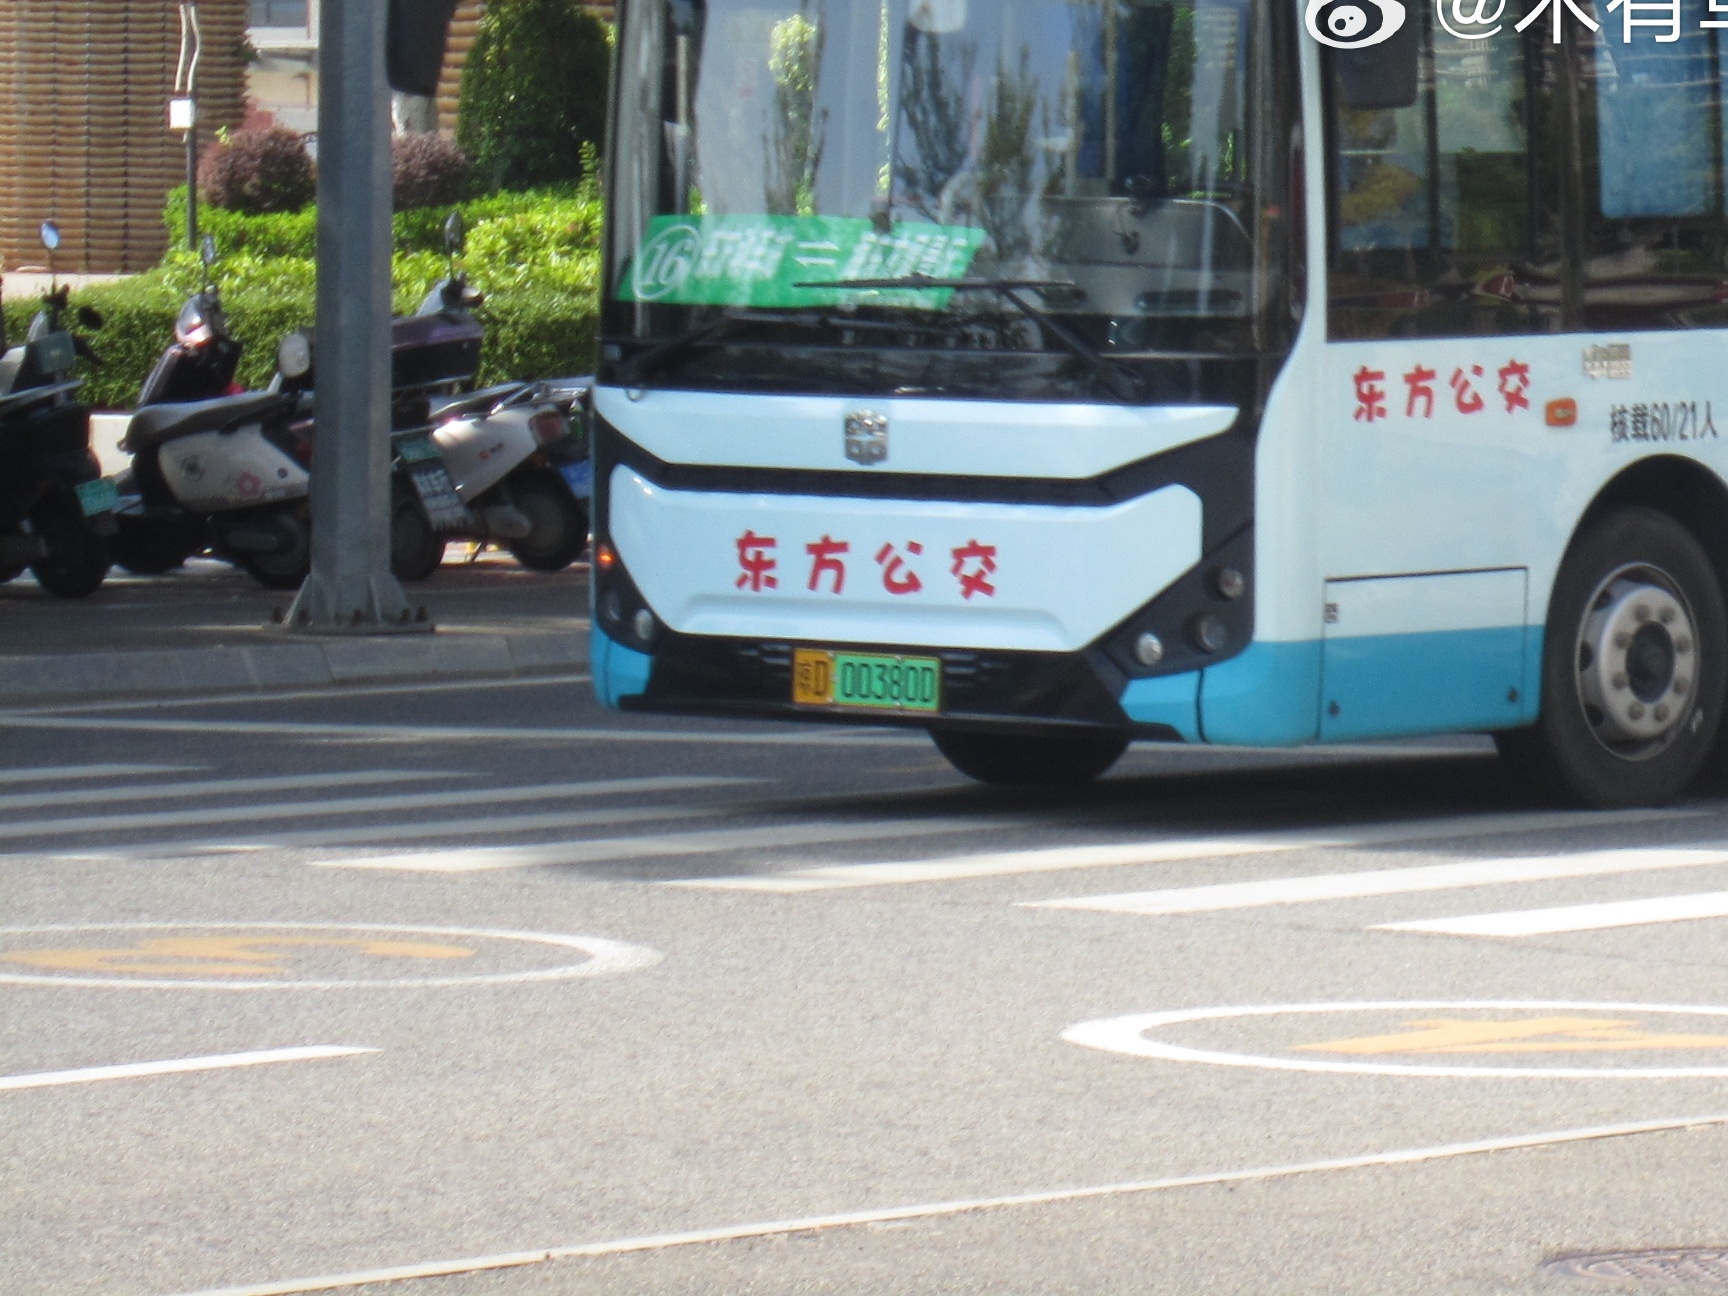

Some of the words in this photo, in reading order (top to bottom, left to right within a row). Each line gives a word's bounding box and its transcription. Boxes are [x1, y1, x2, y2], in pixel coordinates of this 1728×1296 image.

[644, 237, 696, 284] 16
[1352, 359, 1531, 422] 东方公交
[735, 529, 997, 601] 东方公交
